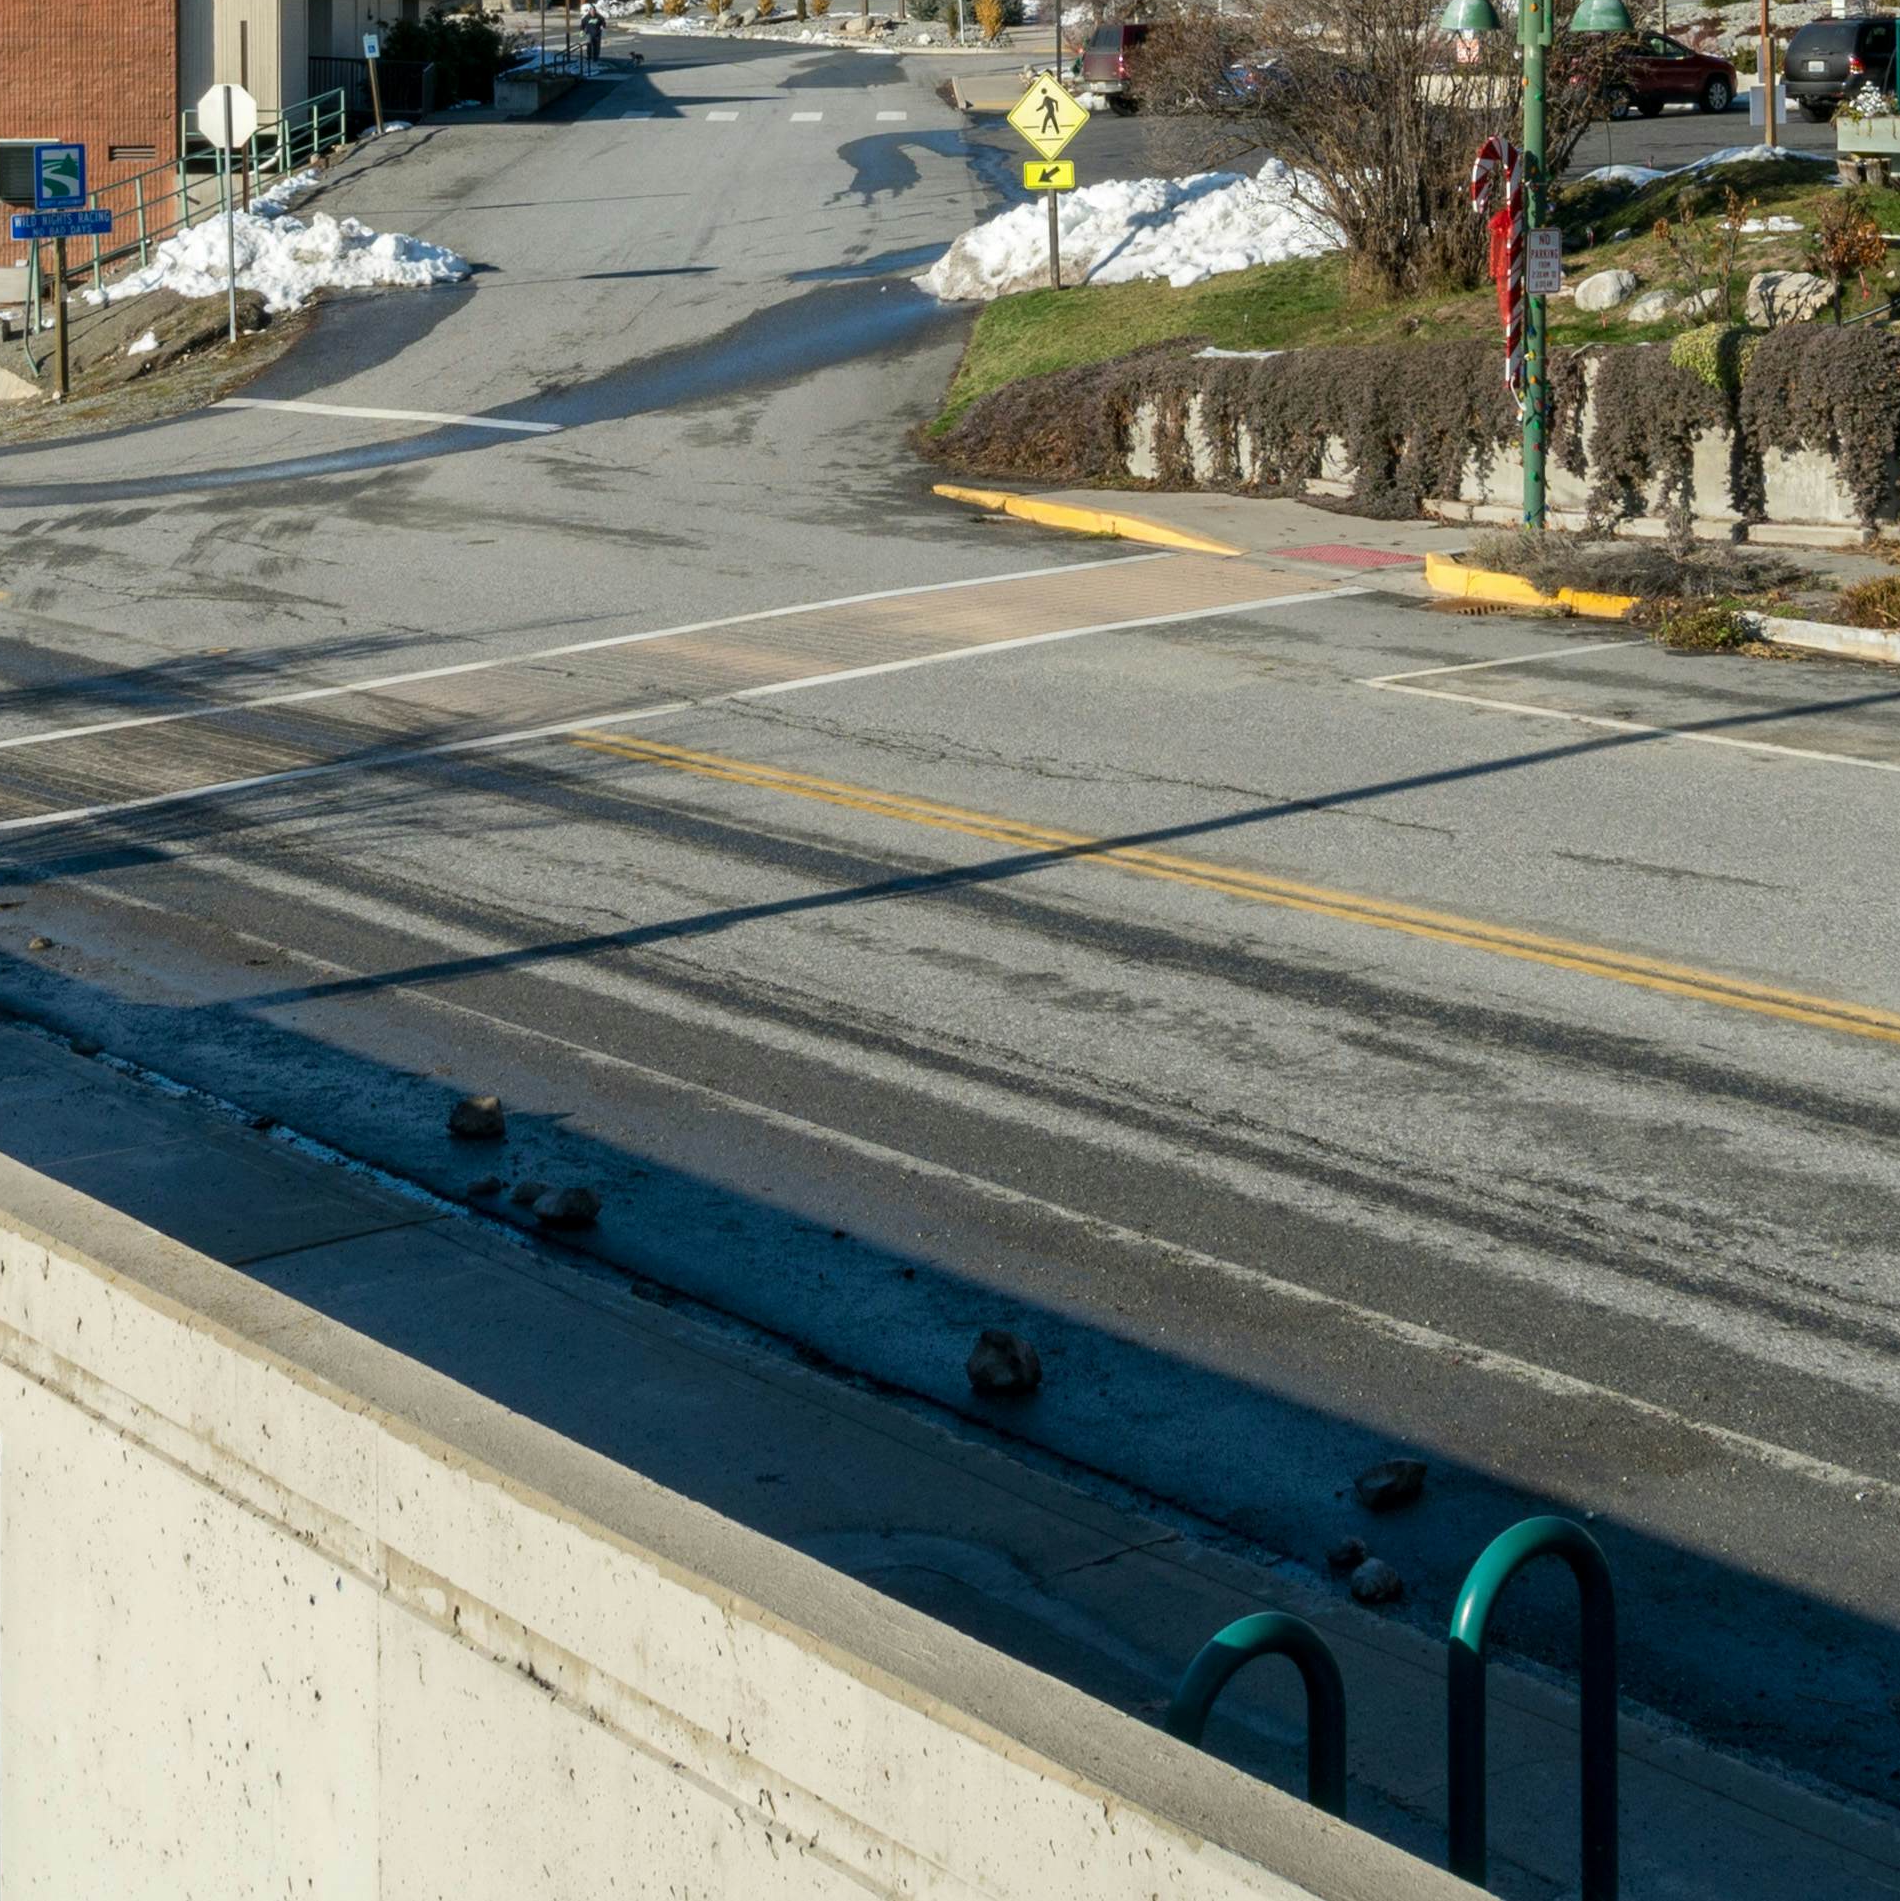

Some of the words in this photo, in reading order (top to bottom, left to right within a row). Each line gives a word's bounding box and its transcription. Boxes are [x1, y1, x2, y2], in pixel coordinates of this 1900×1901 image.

[14, 215, 37, 228] WILD
[42, 213, 72, 226] NIGHTS
[78, 211, 110, 223] RACING
[33, 228, 45, 237] NO
[70, 225, 92, 234] DAYS
[1539, 233, 1550, 245] NO
[1530, 249, 1559, 259] PARKING
